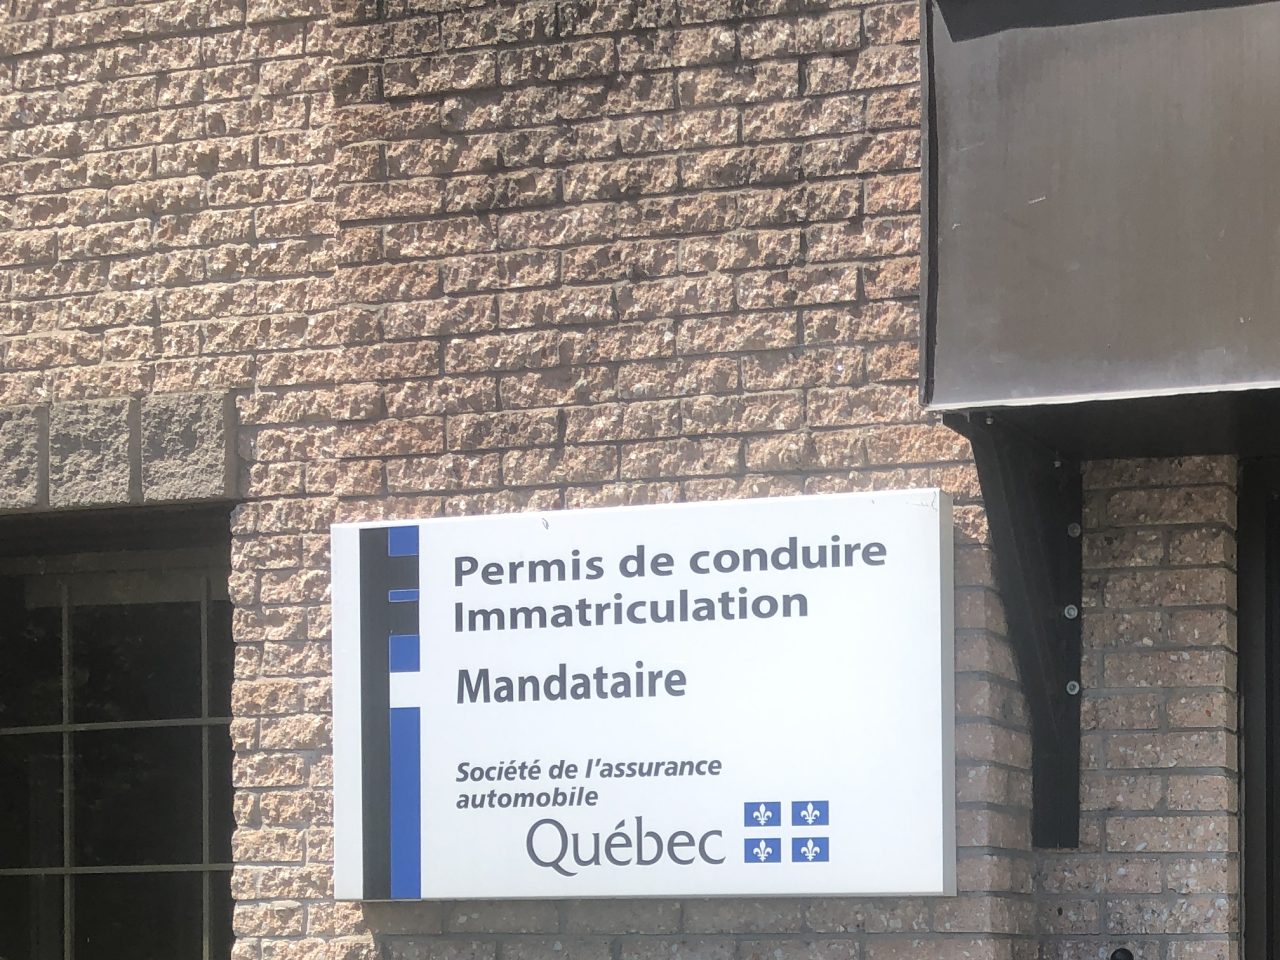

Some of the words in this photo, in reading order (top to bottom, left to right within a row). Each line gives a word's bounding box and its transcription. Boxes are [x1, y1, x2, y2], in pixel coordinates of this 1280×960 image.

[455, 549, 604, 586] Permis
[618, 544, 675, 578] de
[689, 534, 887, 575] conduire
[455, 586, 808, 632] Immatriculation
[456, 660, 687, 704] Mandataire
[456, 759, 542, 782] Société
[548, 759, 578, 779] de
[585, 758, 722, 778] l'assurance
[456, 786, 599, 809] automobile
[526, 815, 726, 877] Québec
